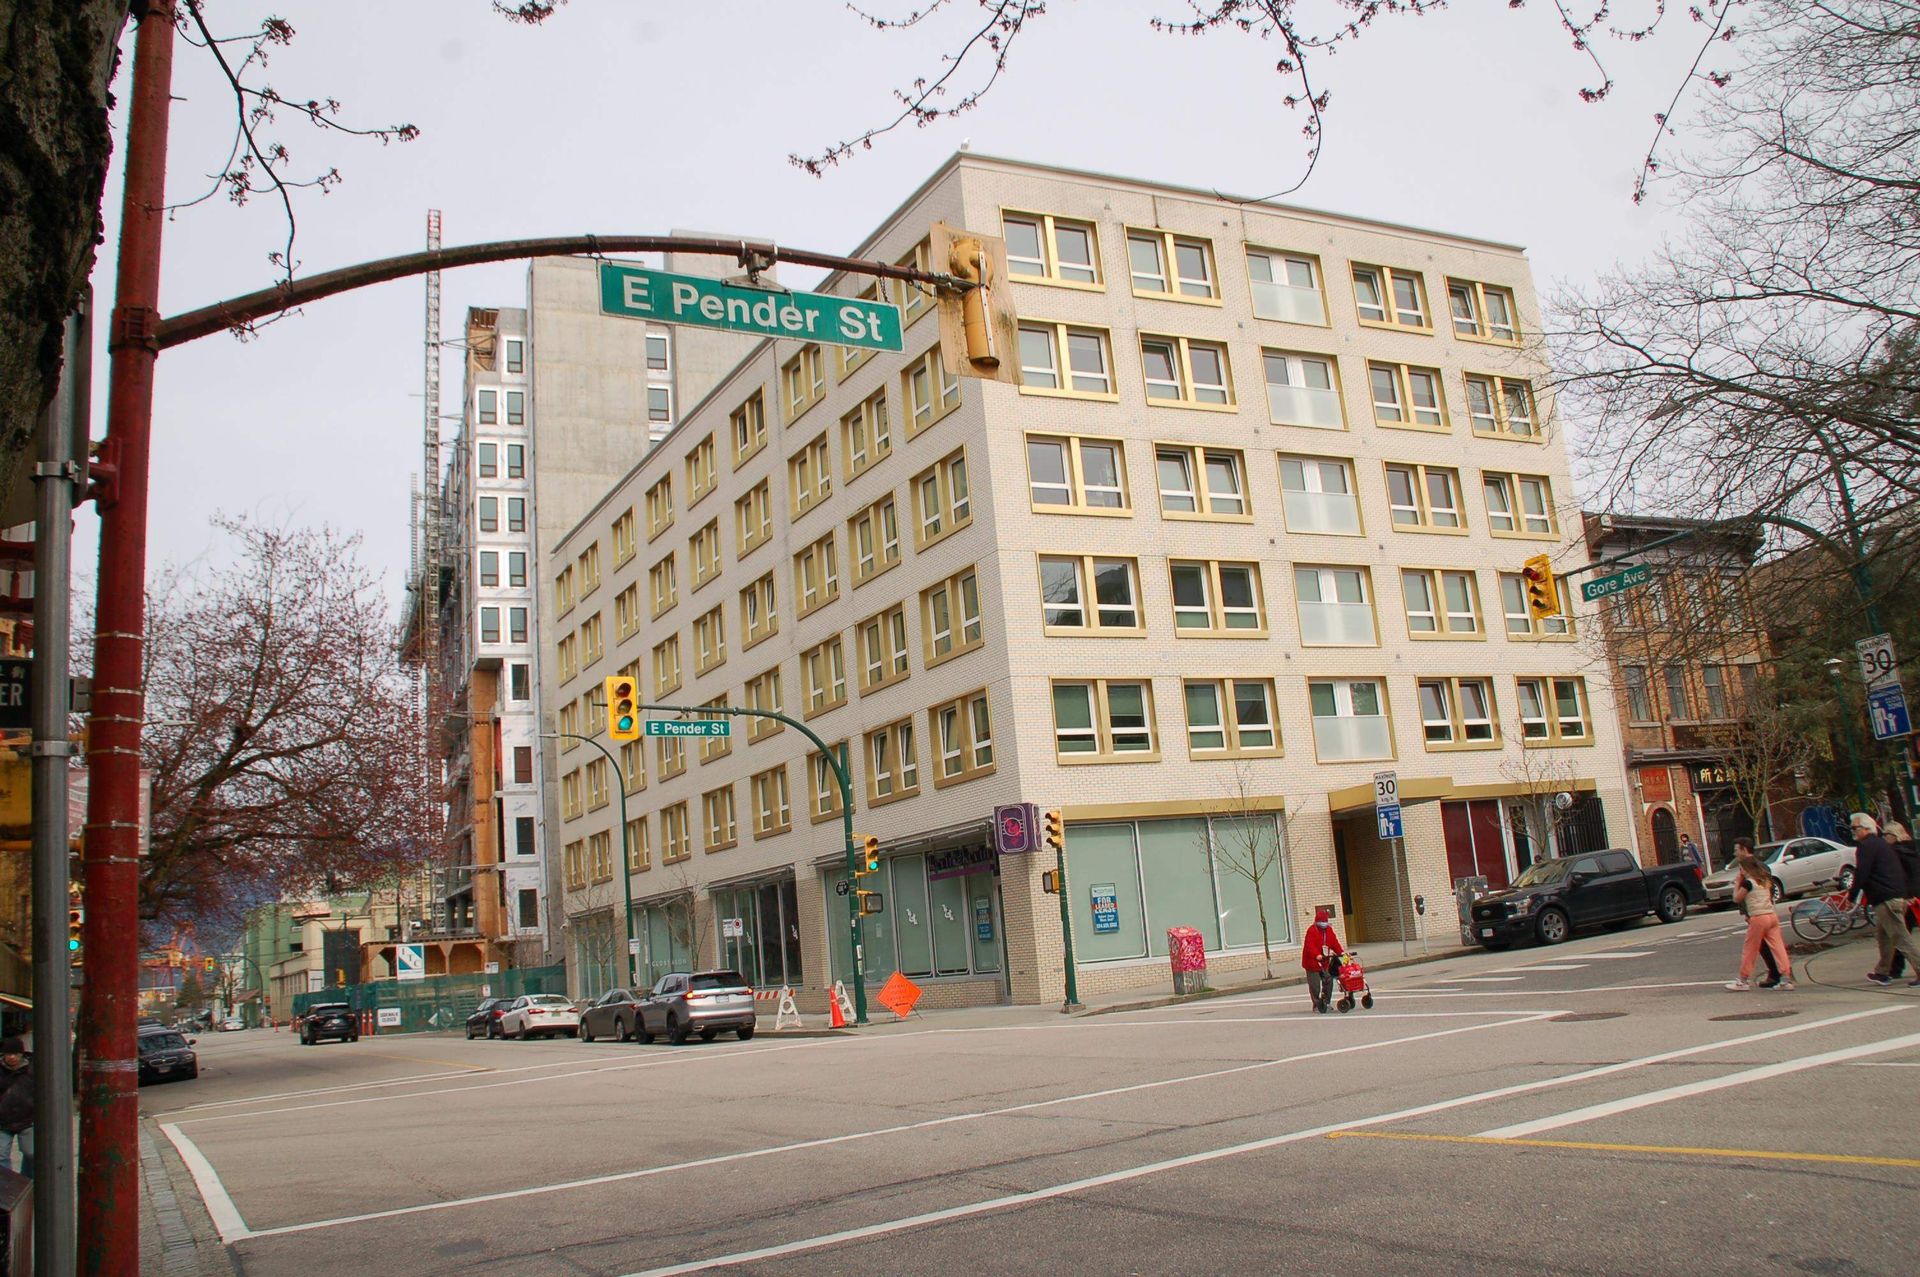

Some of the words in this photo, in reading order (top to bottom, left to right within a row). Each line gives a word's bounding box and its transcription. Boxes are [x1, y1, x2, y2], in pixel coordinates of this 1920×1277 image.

[623, 275, 651, 310] E
[672, 281, 820, 333] Pender
[839, 305, 884, 342] St
[1587, 579, 1617, 597] Gore
[1622, 570, 1646, 585] Ave
[1863, 649, 1891, 674] 30
[651, 723, 659, 734] E
[664, 723, 706, 734] Pender
[711, 723, 725, 734] St
[1377, 780, 1395, 796] 30
